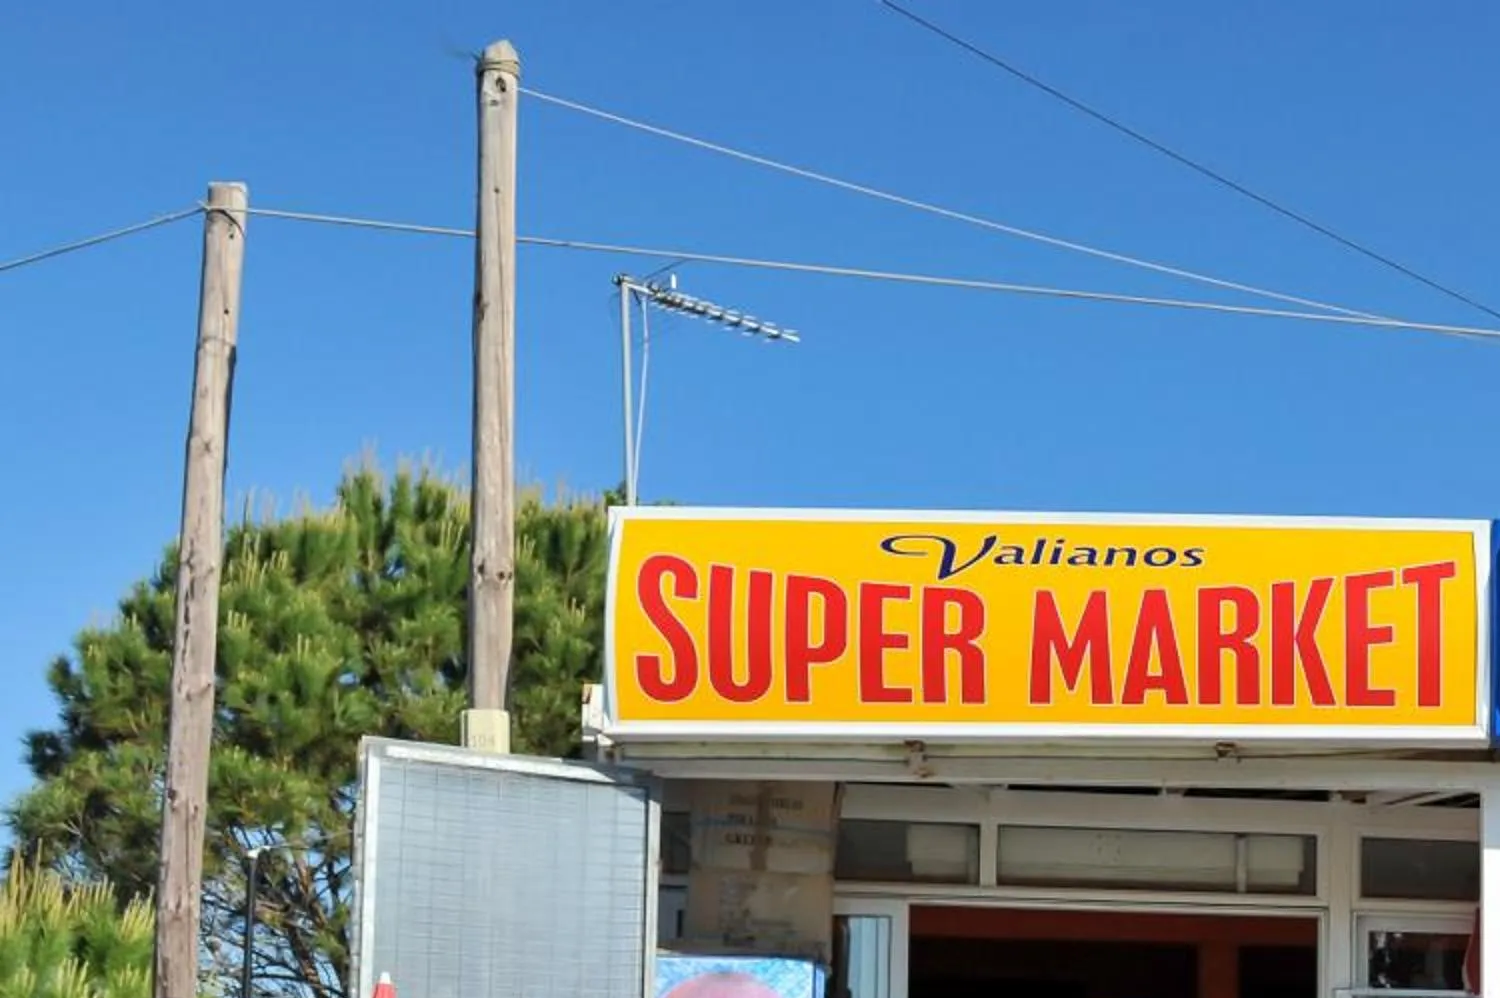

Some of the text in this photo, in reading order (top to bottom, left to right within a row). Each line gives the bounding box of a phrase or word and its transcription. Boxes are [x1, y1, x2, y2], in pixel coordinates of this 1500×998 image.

[881, 534, 1204, 580] Valianos
[636, 554, 1456, 707] SUPER MARKET
